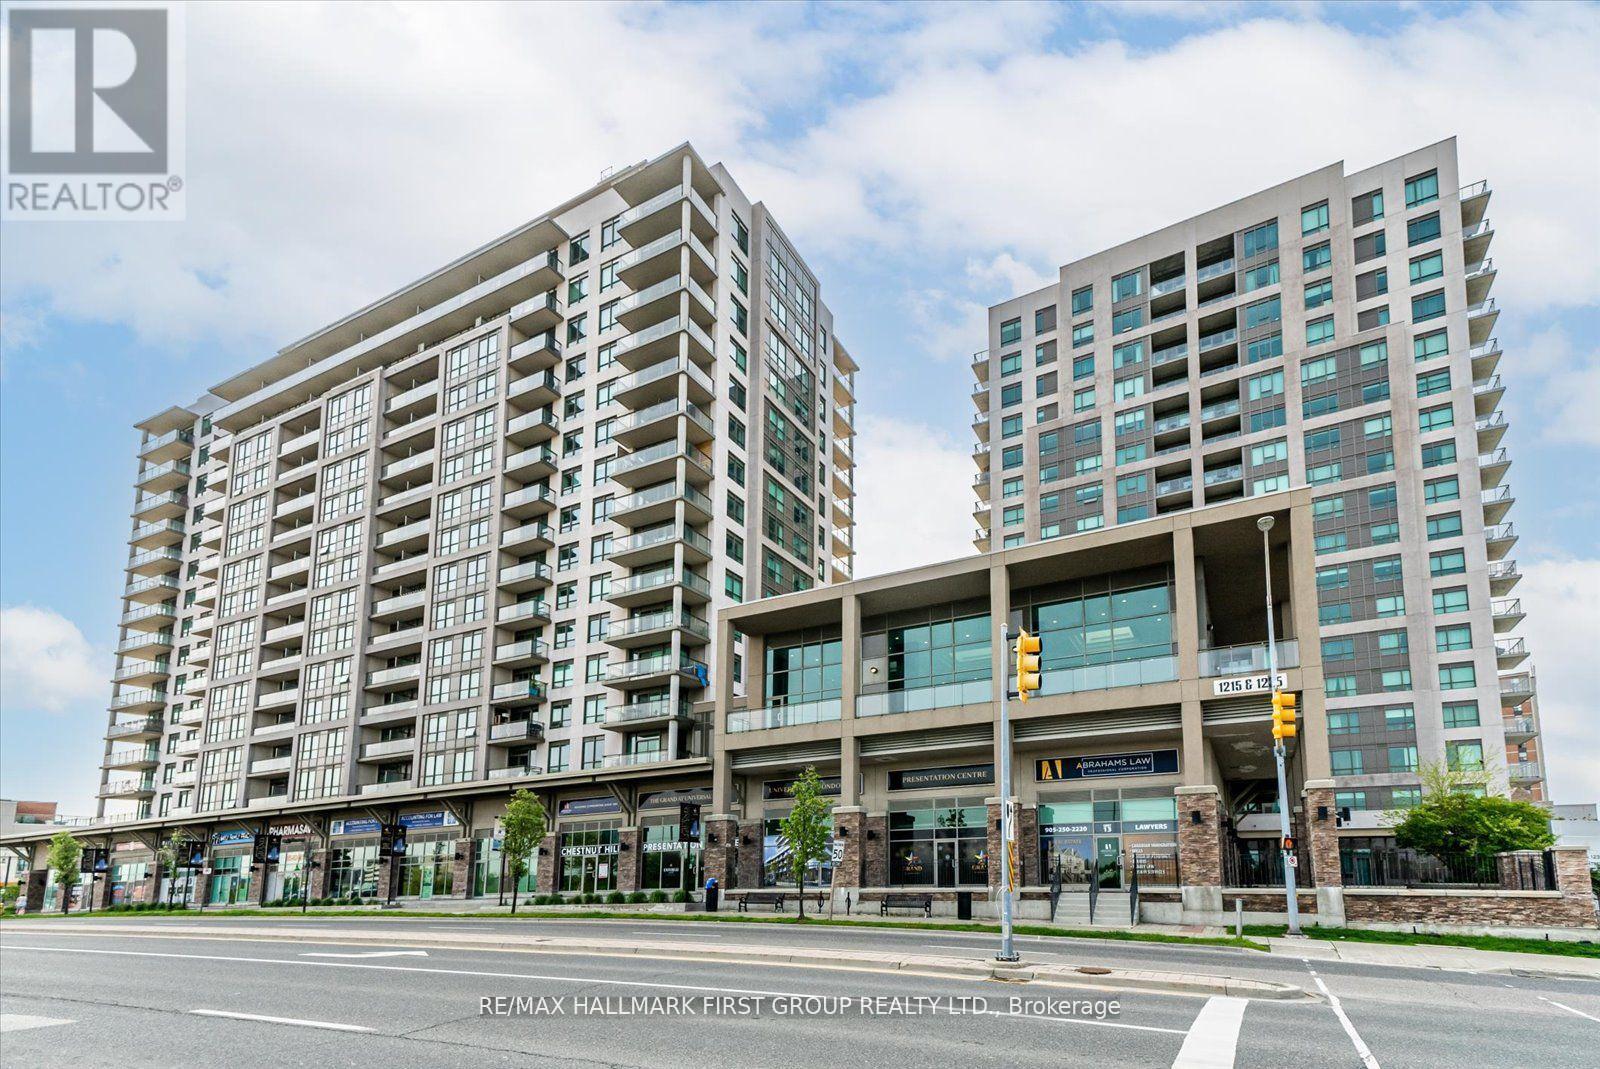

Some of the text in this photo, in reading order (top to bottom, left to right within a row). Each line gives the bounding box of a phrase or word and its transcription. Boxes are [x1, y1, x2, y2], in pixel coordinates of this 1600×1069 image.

[1219, 675, 1283, 693] 1215 & 125
[1076, 757, 1151, 769] ABRAHAMS LAW
[902, 770, 987, 783] PRESENTATION CENTRE
[660, 795, 677, 803] GRAND
[685, 793, 712, 802] UNIVERSAL
[269, 824, 317, 836] PHARMASAV
[1044, 825, 1088, 833] 905-250-2220
[1135, 823, 1168, 831] LAWYERS
[561, 846, 602, 856] CHESTNUT
[643, 841, 702, 851] PRESENTATON
[833, 849, 843, 860] 50
